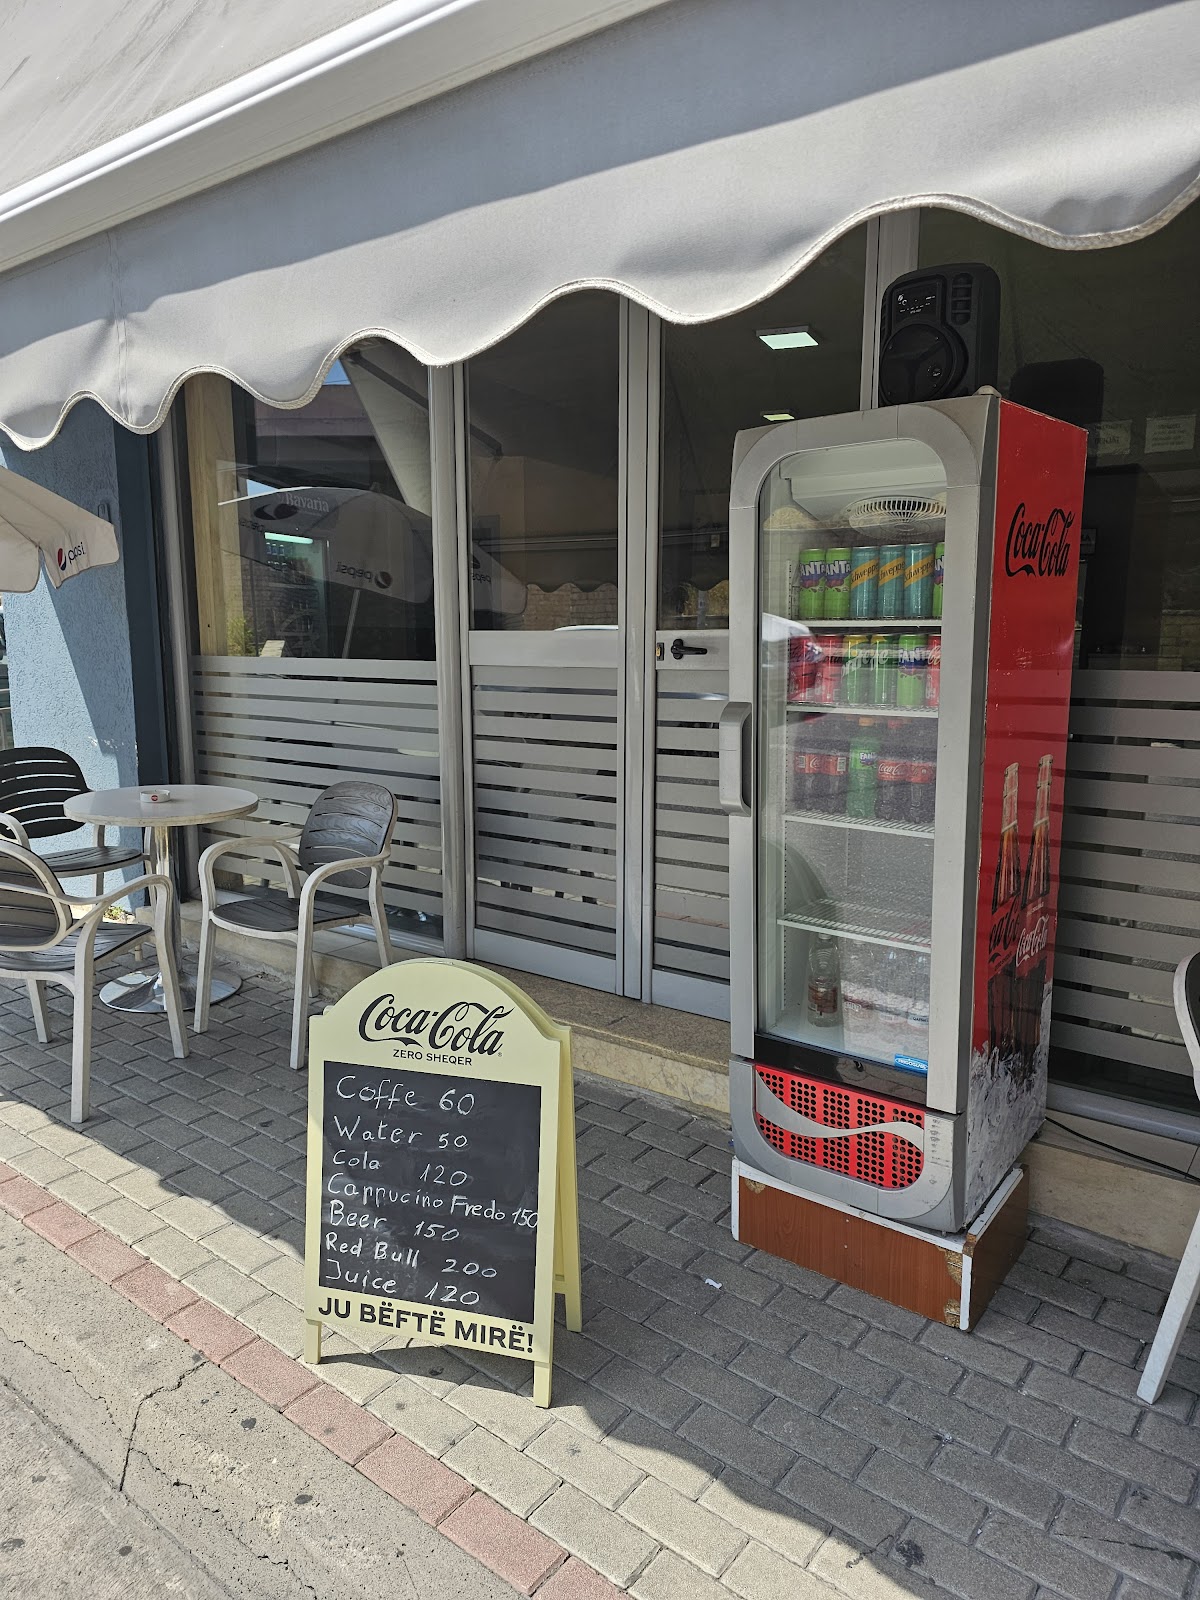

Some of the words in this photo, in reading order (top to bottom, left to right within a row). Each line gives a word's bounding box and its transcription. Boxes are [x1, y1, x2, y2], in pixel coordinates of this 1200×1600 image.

[286, 492, 330, 513] Bavaria
[1005, 502, 1076, 578] Coca-Cola
[1015, 913, 1050, 967] Coca-Cola
[358, 993, 516, 1056] Coca-Cola
[393, 1048, 423, 1061] ZERO
[426, 1052, 473, 1066] SHEQER
[336, 1075, 419, 1111] Coffe
[439, 1088, 475, 1116] 60
[334, 1115, 423, 1145] Water
[438, 1132, 468, 1149] 50
[332, 1149, 381, 1170] Cola
[419, 1163, 468, 1187] 120
[329, 1199, 387, 1229] Beer
[414, 1220, 460, 1242] 150
[450, 1194, 506, 1221] Fredo
[512, 1207, 539, 1228] 150
[325, 1231, 362, 1258] Red
[374, 1241, 420, 1269] Bull
[441, 1258, 498, 1278] 200
[325, 1258, 397, 1294] Juice
[424, 1282, 480, 1306] 120
[318, 1297, 351, 1319] JU
[359, 1301, 446, 1338] BËFTË
[454, 1320, 534, 1354] MIRË!
